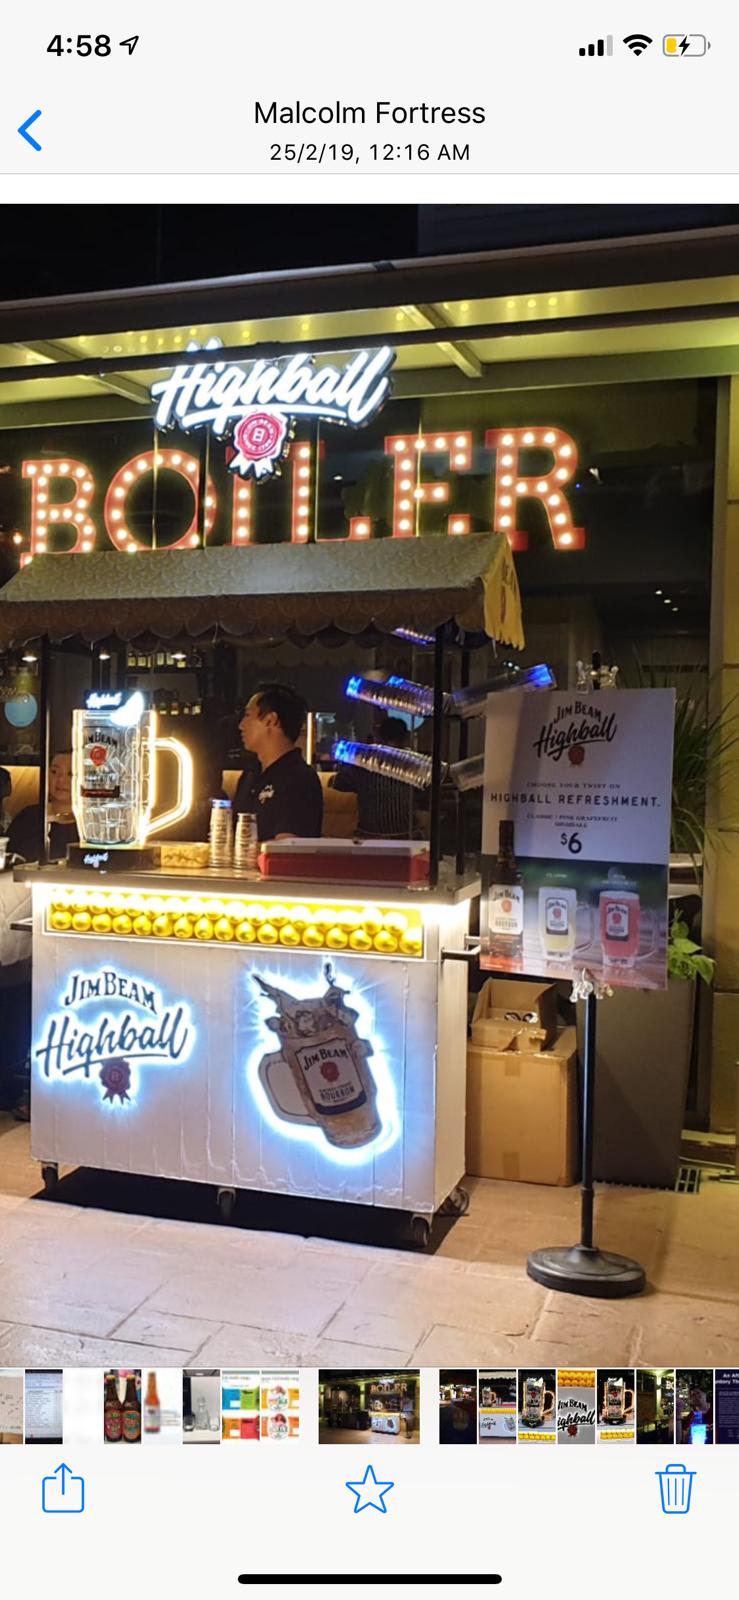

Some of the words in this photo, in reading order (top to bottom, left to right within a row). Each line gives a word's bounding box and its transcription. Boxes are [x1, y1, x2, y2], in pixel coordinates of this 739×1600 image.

[47, 35, 111, 57] 4:58
[256, 101, 365, 123] Malcolm
[377, 102, 485, 123] Fortress
[271, 144, 359, 164] 25/2/19,
[370, 144, 429, 160] 12:16
[438, 144, 469, 160] AM
[151, 337, 390, 435] Highball
[20, 426, 586, 569] BOILER
[553, 705, 573, 724] JIM
[575, 700, 601, 722] BEAM
[532, 711, 618, 762] Highball
[490, 793, 552, 805] HIGHBALL
[558, 794, 662, 808] REFRESHMENT.
[560, 832, 583, 854] $6
[65, 975, 101, 1006] JIM
[102, 971, 158, 1015] BEAM
[35, 1007, 189, 1078] Highball
[303, 1053, 320, 1071] JIM
[319, 1048, 349, 1060] BEAM
